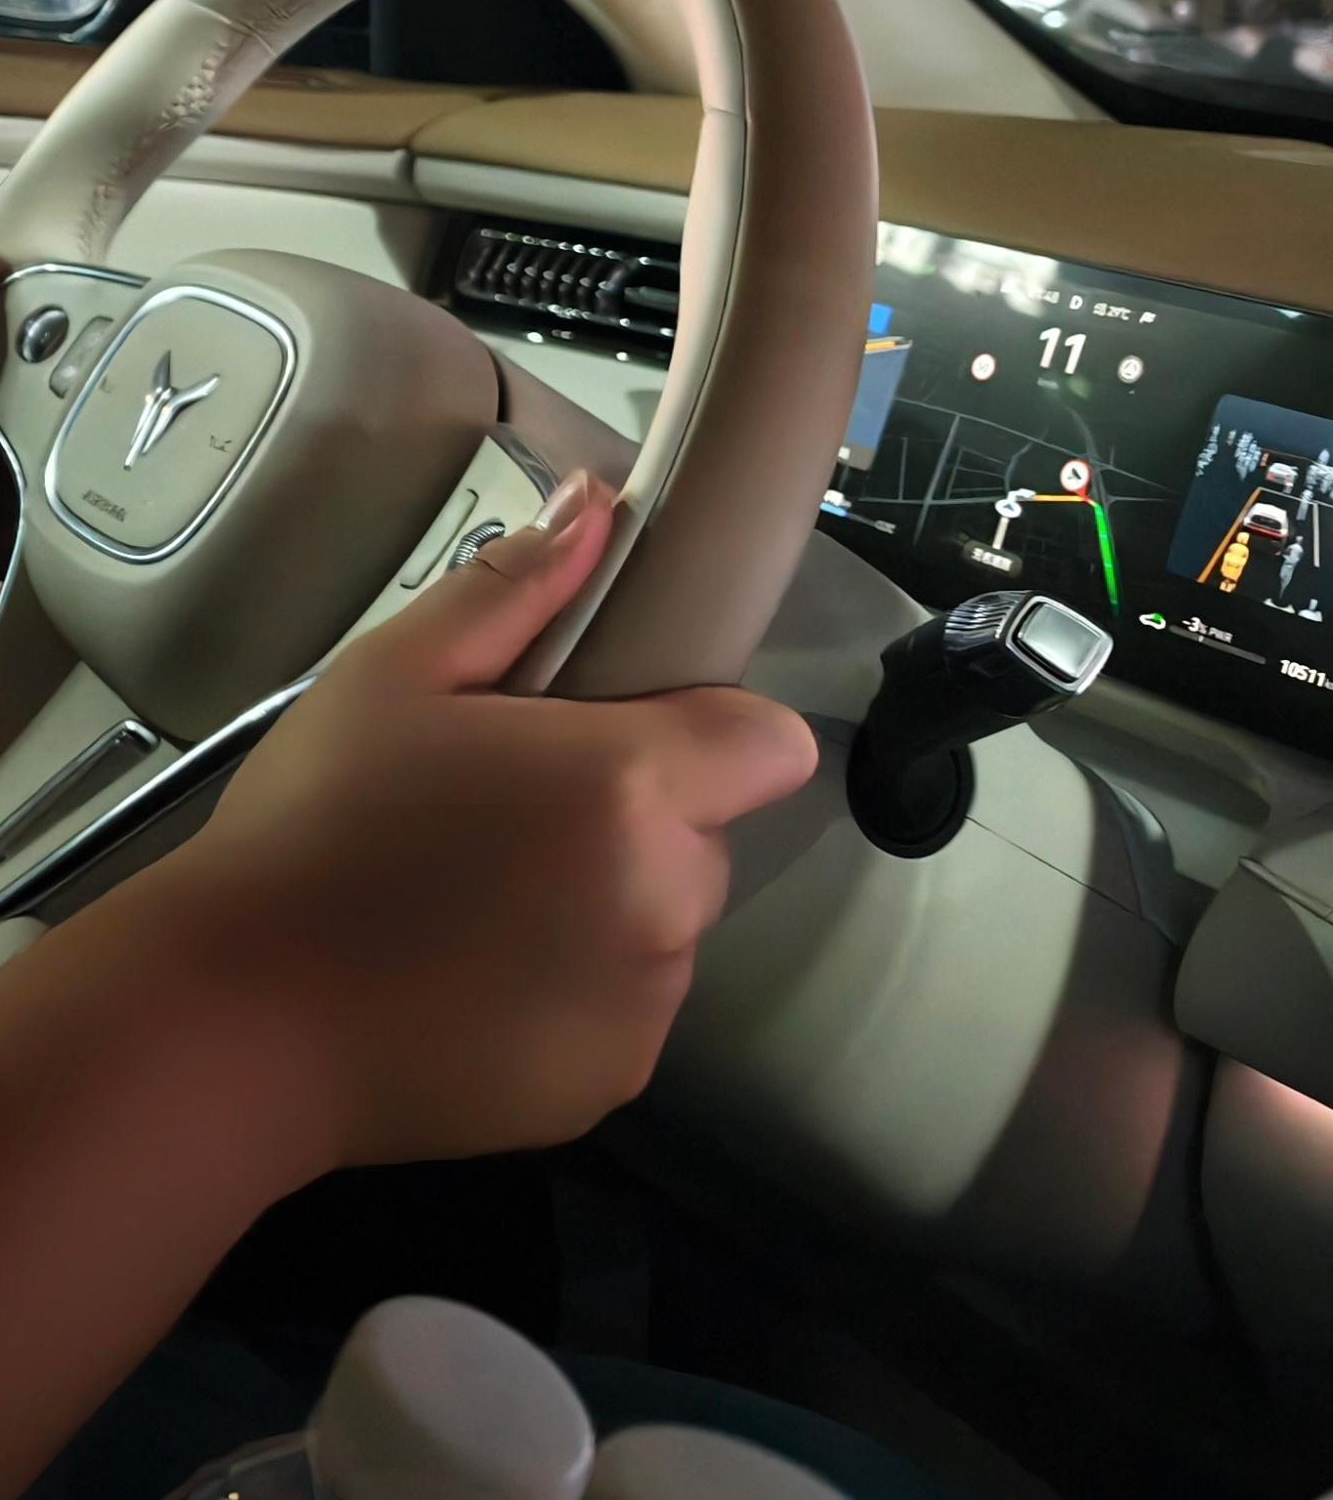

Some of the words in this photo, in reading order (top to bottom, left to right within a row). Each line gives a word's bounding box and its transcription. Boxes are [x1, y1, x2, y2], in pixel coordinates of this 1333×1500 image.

[1069, 295, 1083, 310] D
[1039, 327, 1087, 375] 11
[1280, 659, 1326, 687] 10511
